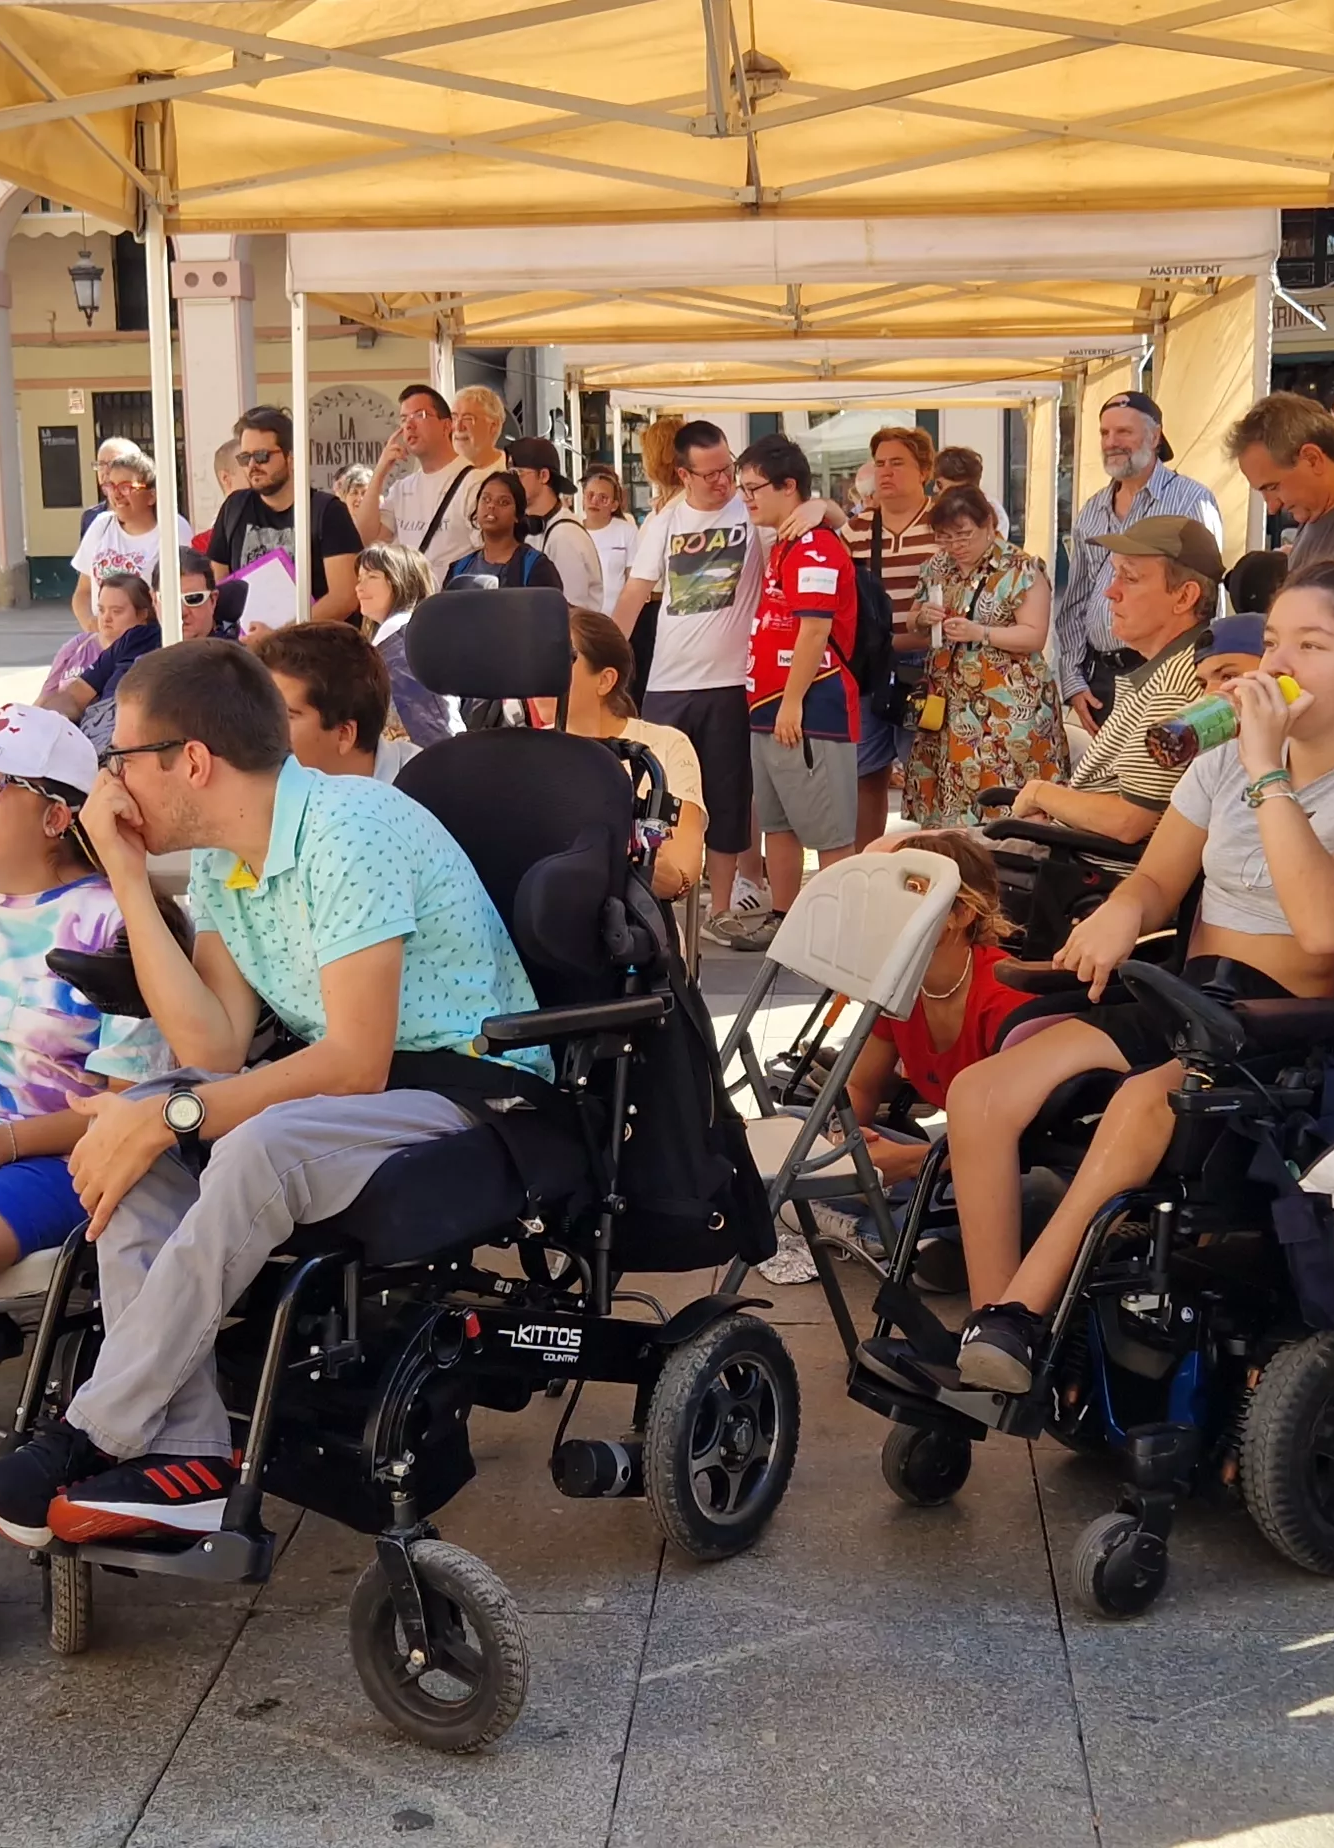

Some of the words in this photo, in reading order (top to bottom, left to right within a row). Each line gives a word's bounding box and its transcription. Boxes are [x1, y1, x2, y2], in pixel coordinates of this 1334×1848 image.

[1149, 264, 1222, 276] MASTERTENT
[338, 413, 356, 440] LA
[309, 439, 388, 466] TRASTIEND
[671, 525, 747, 556] ROAD
[517, 1323, 583, 1347] KITTOS
[543, 1352, 579, 1363] COUNTRY
